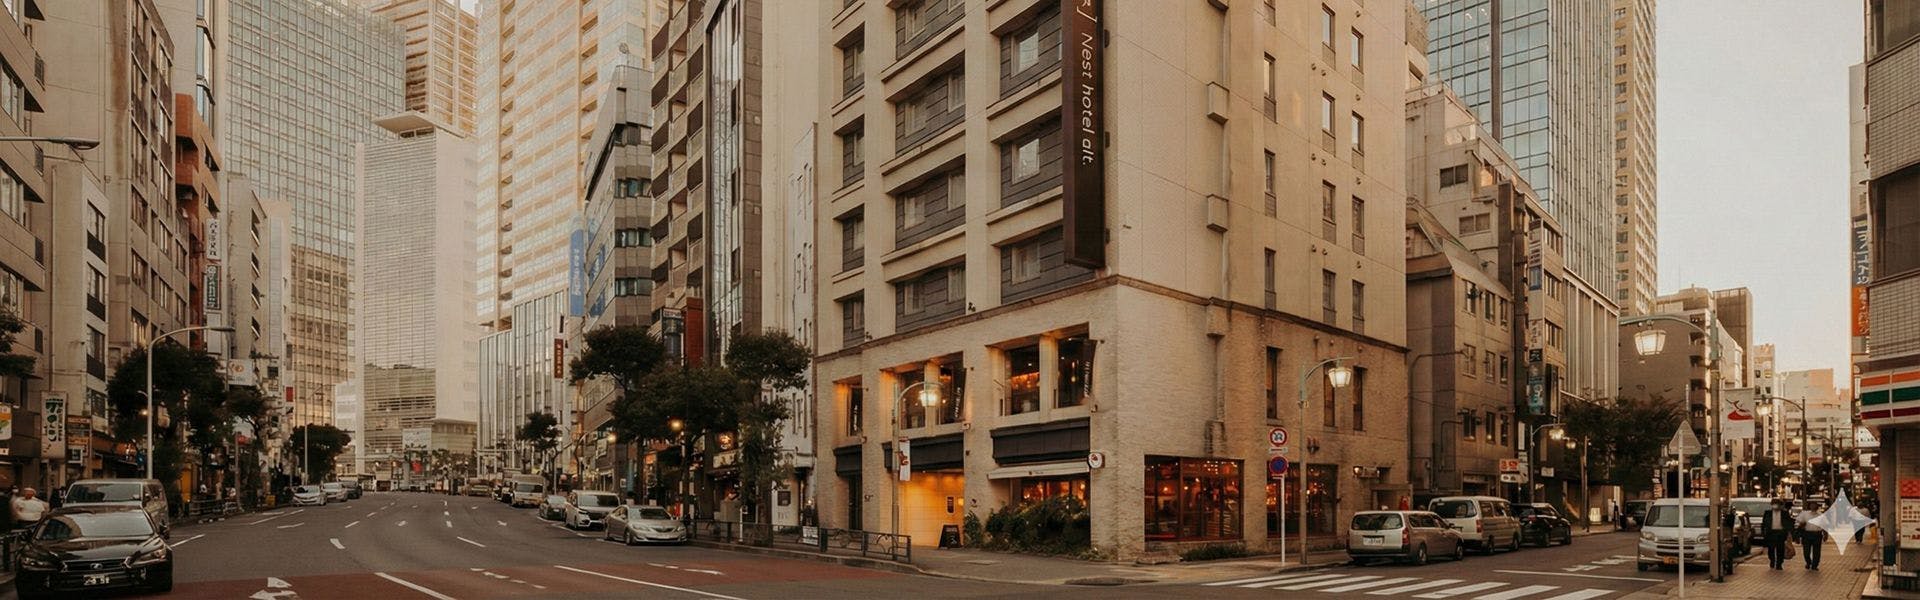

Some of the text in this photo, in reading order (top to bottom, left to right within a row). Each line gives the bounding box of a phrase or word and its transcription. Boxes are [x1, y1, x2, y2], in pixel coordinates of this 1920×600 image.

[1081, 32, 1094, 79] Nest
[1081, 83, 1096, 134] hotel
[1081, 138, 1095, 165] alt.
